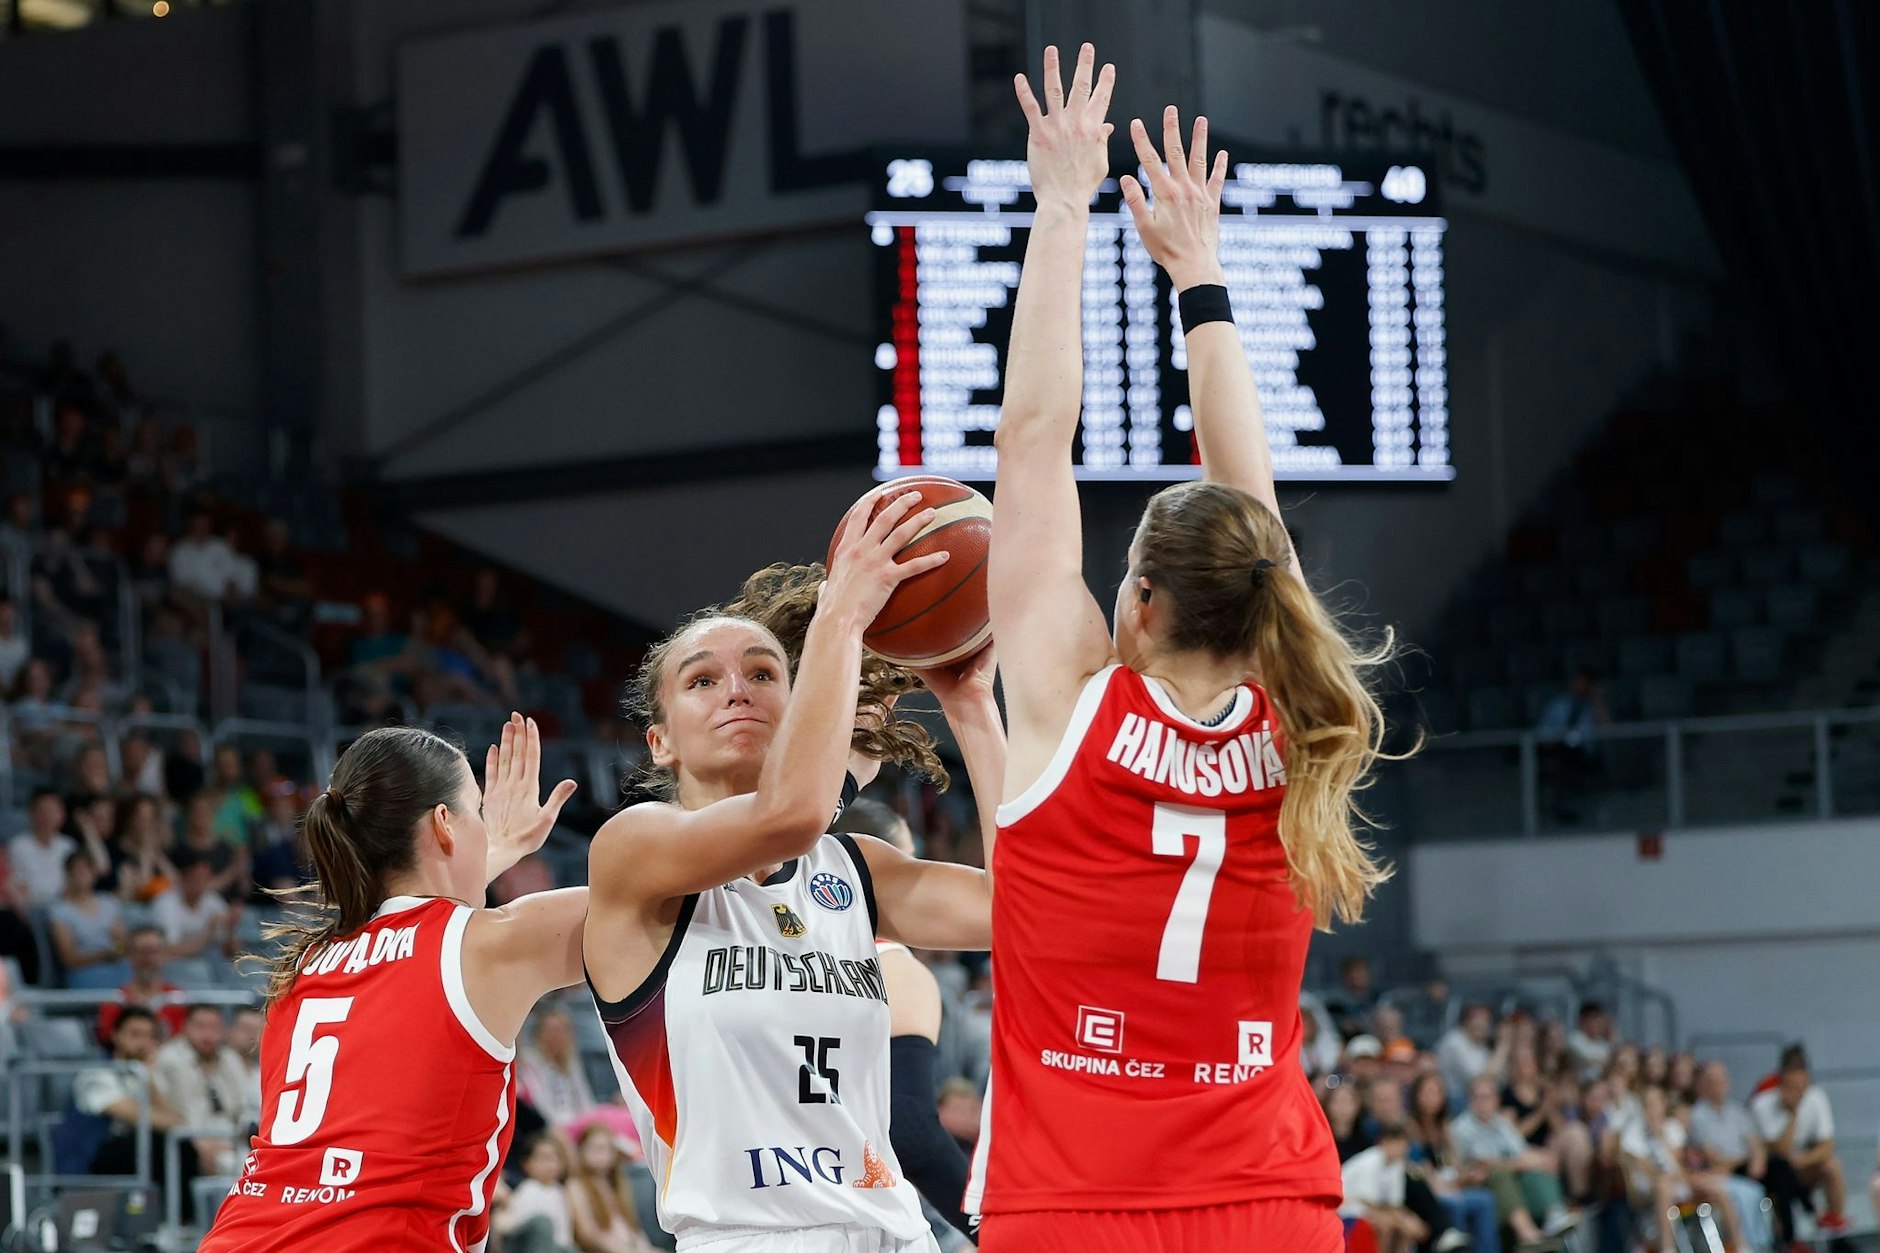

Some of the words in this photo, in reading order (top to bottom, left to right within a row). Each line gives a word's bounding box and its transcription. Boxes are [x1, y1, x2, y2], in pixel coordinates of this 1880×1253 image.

[453, 9, 868, 239] AWL
[1151, 800, 1227, 984] 7
[1040, 1049, 1121, 1076] SKUPINA
[1125, 1058, 1165, 1079] ČEZ
[1247, 1033, 1264, 1055] R
[270, 996, 355, 1145] 5
[793, 1035, 842, 1104] 25
[243, 1179, 268, 1197] ČEZ
[332, 1156, 351, 1178] R
[744, 1146, 845, 1190] ING
